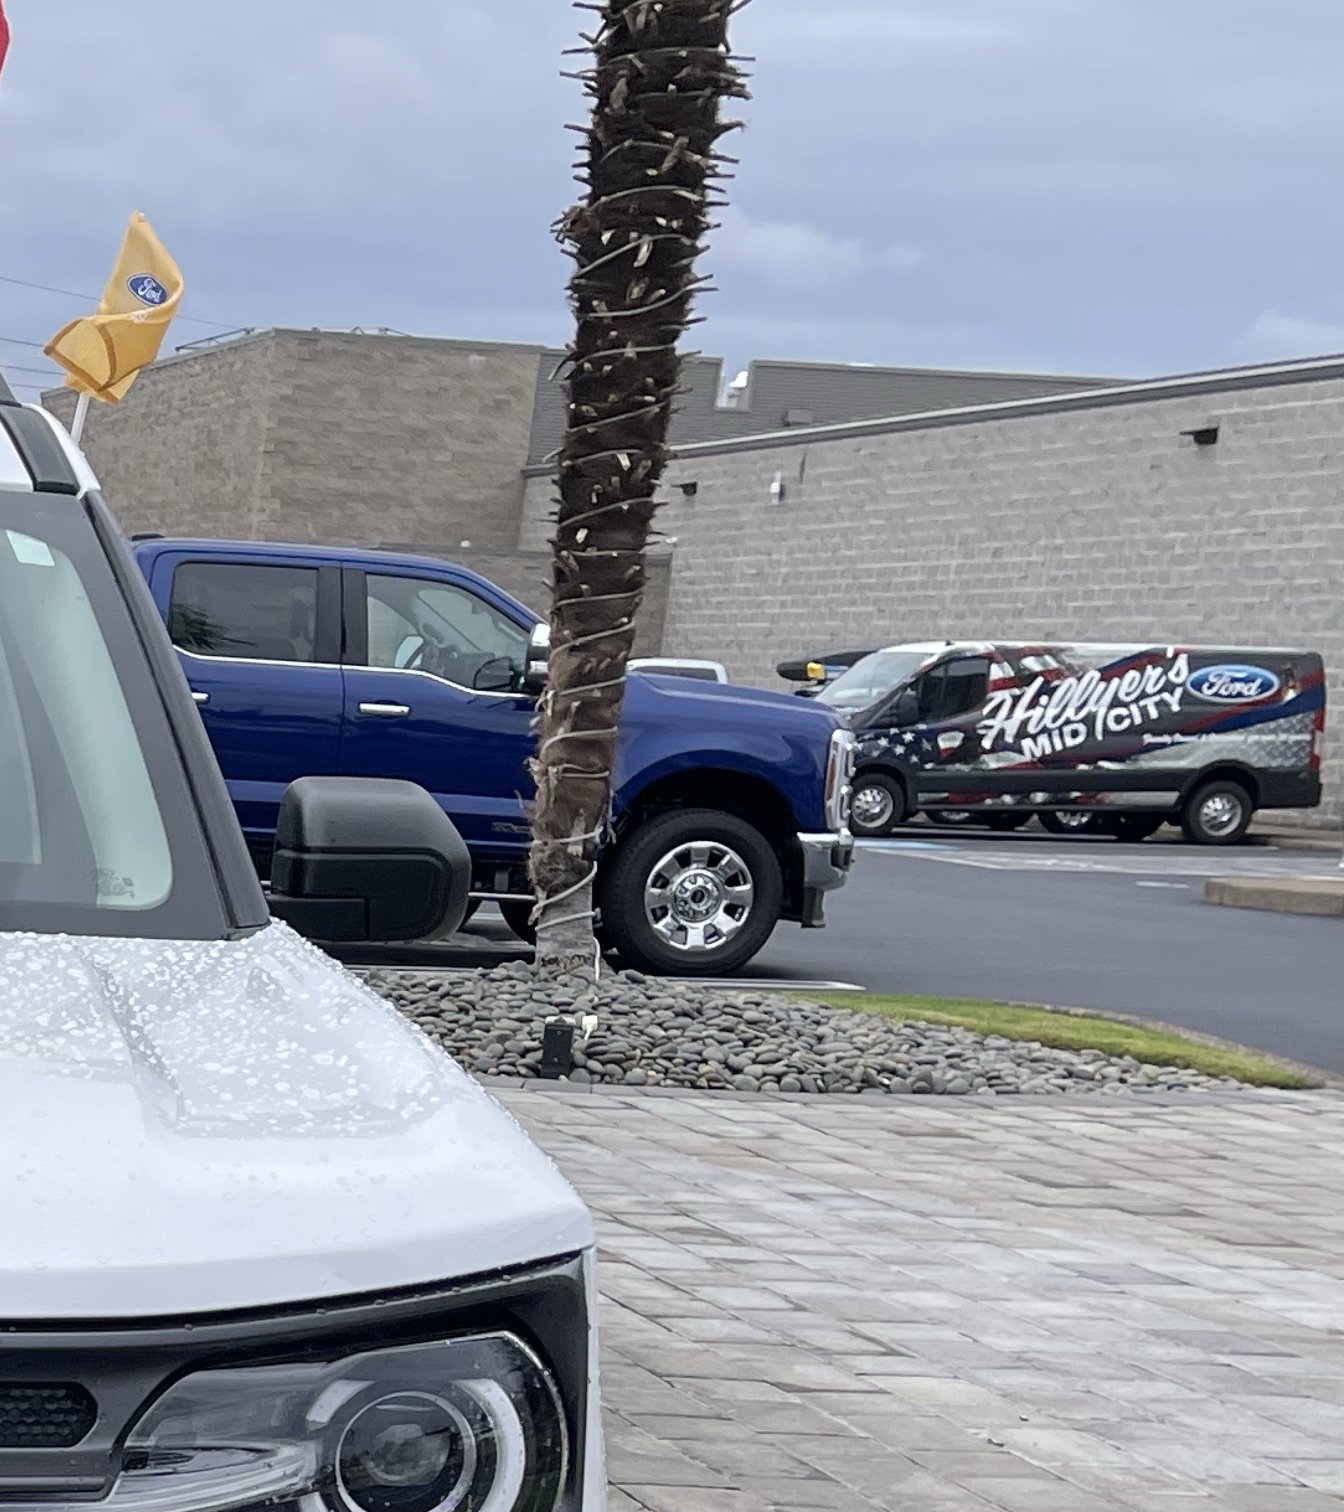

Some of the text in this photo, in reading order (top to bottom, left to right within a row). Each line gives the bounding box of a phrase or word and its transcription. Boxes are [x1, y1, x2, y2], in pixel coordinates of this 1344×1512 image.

[976, 646, 1189, 750] Hillyer's
[1201, 669, 1263, 697] Ford
[1020, 686, 1184, 761] MID CITY
